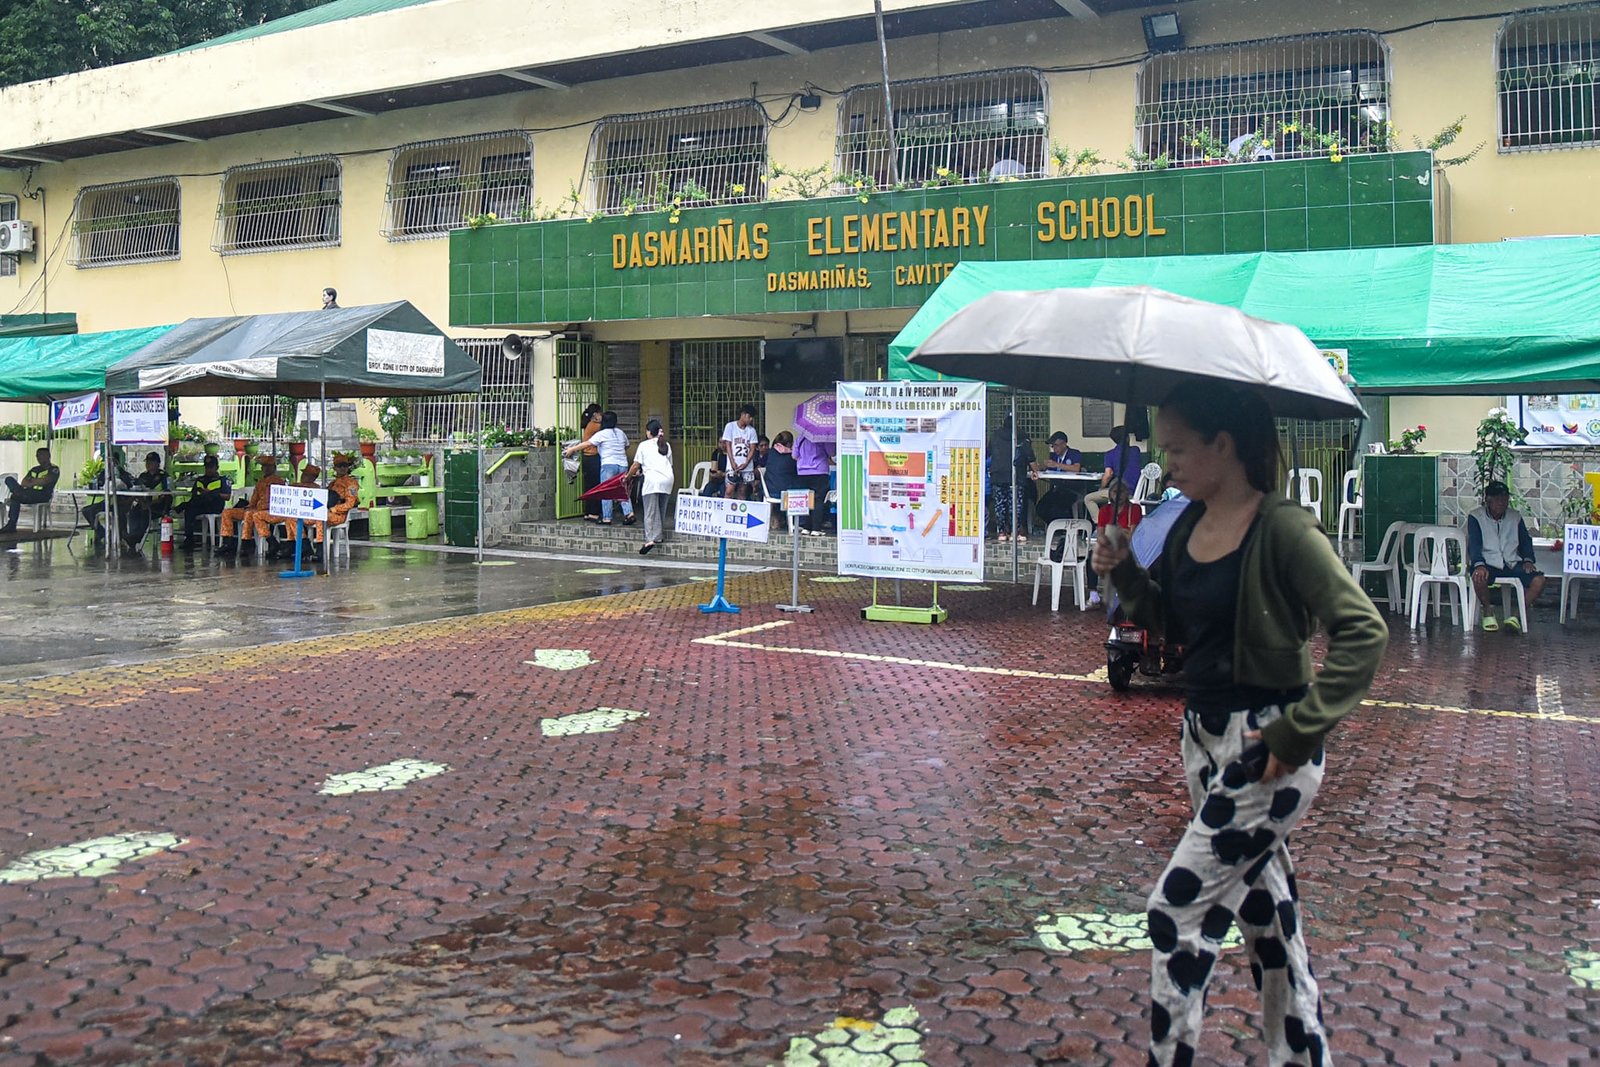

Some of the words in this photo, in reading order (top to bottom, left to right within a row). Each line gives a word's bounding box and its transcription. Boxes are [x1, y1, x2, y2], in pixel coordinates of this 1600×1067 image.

[613, 218, 769, 269] DASMARIÑAS
[808, 205, 988, 256] ELEMENTARY
[1038, 193, 1166, 242] SCHOOL
[767, 264, 871, 292] DASMARIÑAS,
[865, 387, 880, 397] ZONE
[899, 388, 904, 397] &
[906, 387, 912, 397] IV
[943, 387, 958, 397] MAP
[68, 404, 85, 415] VAD
[117, 400, 130, 413] POLICE
[131, 400, 155, 413] ASSISTANCE
[155, 400, 166, 412] DESK
[950, 402, 982, 410] SCHOOL
[880, 435, 894, 443] ZONE
[735, 446, 749, 457] 23
[272, 496, 292, 505] PRIORITY
[680, 497, 691, 507] THIS
[693, 498, 704, 508] WAY
[705, 500, 712, 509] TO
[714, 500, 724, 510] THE
[789, 500, 804, 508] ZONE
[287, 507, 298, 516] PLACE
[679, 509, 713, 521] PRIORITY
[678, 521, 702, 532] POLLING
[704, 525, 721, 535] PLACE
[1568, 528, 1588, 540] THIS
[1592, 529, 1600, 541] W
[1568, 543, 1600, 556] PRIO
